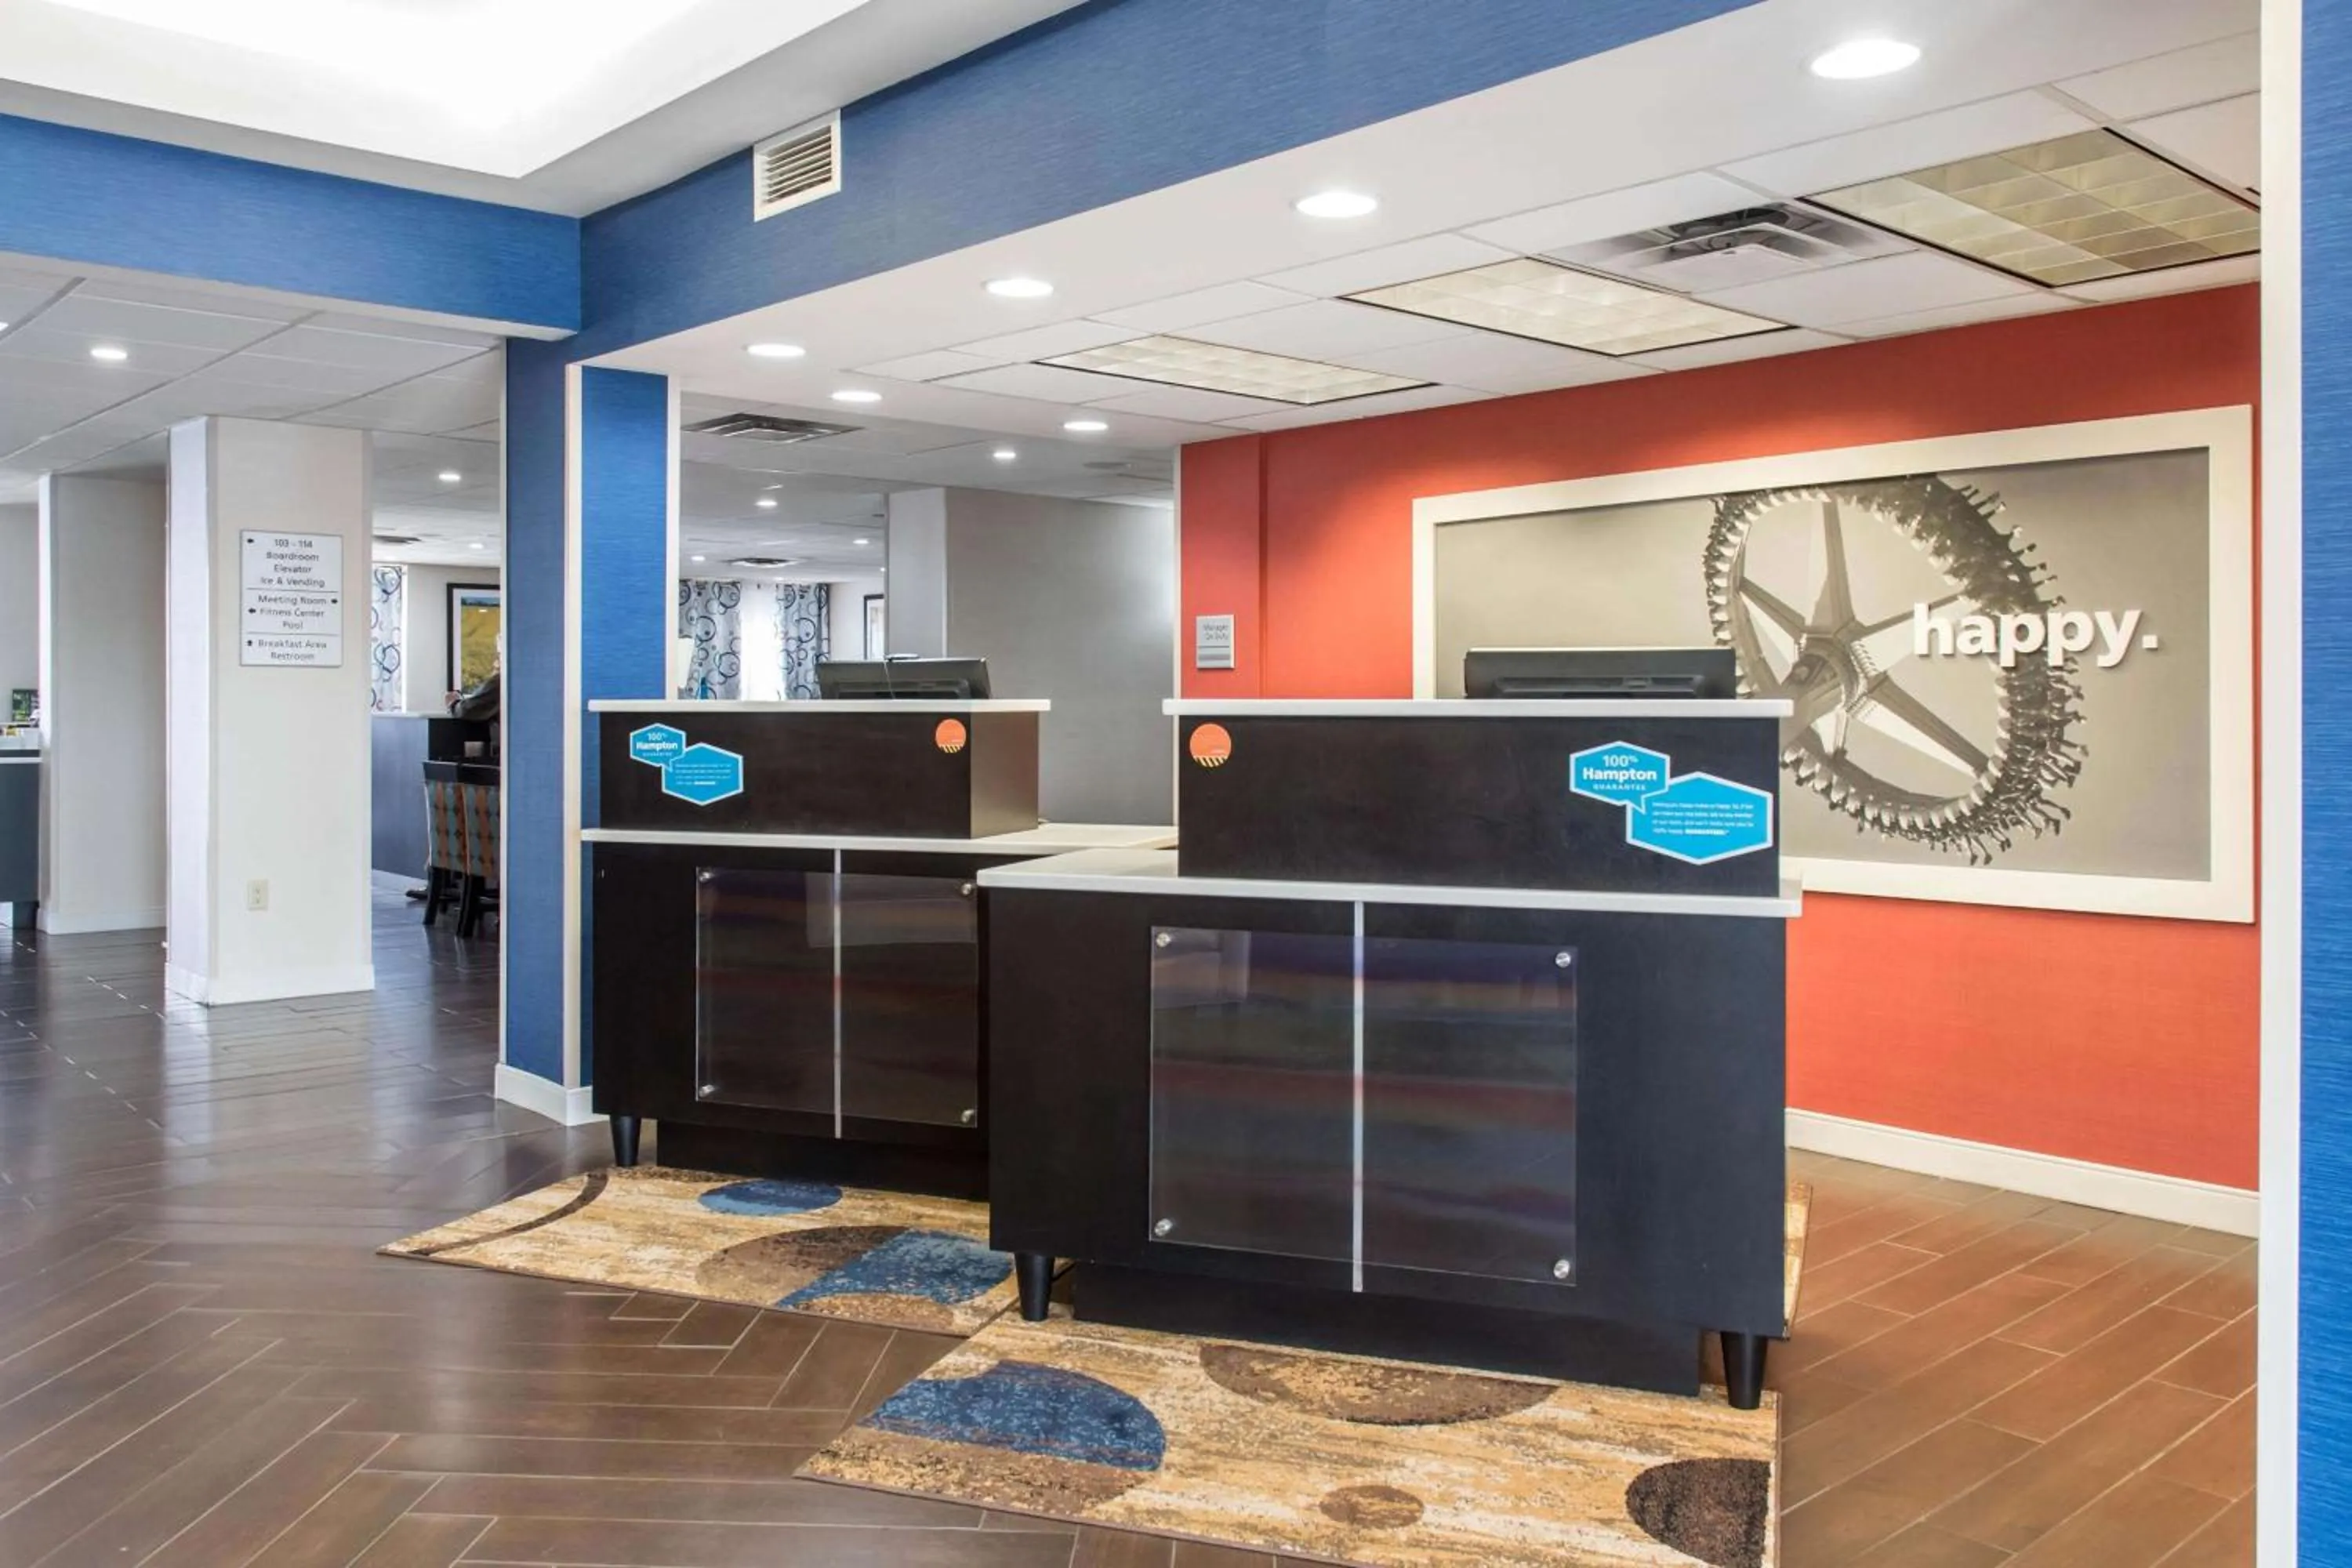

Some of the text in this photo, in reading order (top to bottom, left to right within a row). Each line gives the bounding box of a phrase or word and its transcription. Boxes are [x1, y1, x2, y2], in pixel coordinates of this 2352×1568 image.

[274, 539, 289, 547] 103
[298, 539, 313, 548] 114
[267, 551, 319, 562] Boardroom
[274, 564, 311, 573] Elevator
[260, 576, 274, 585] Ice
[286, 578, 325, 588] Vending
[258, 594, 327, 605] Meeting Room
[260, 607, 324, 617] Fitness Center
[282, 620, 303, 630] Pool
[1914, 602, 2158, 667] happy.
[258, 639, 327, 648] Breakfast Area
[271, 652, 315, 661] Restroom
[636, 742, 678, 751] Hampton
[1602, 754, 1639, 768] 100%
[1582, 767, 1657, 782] Hampton
